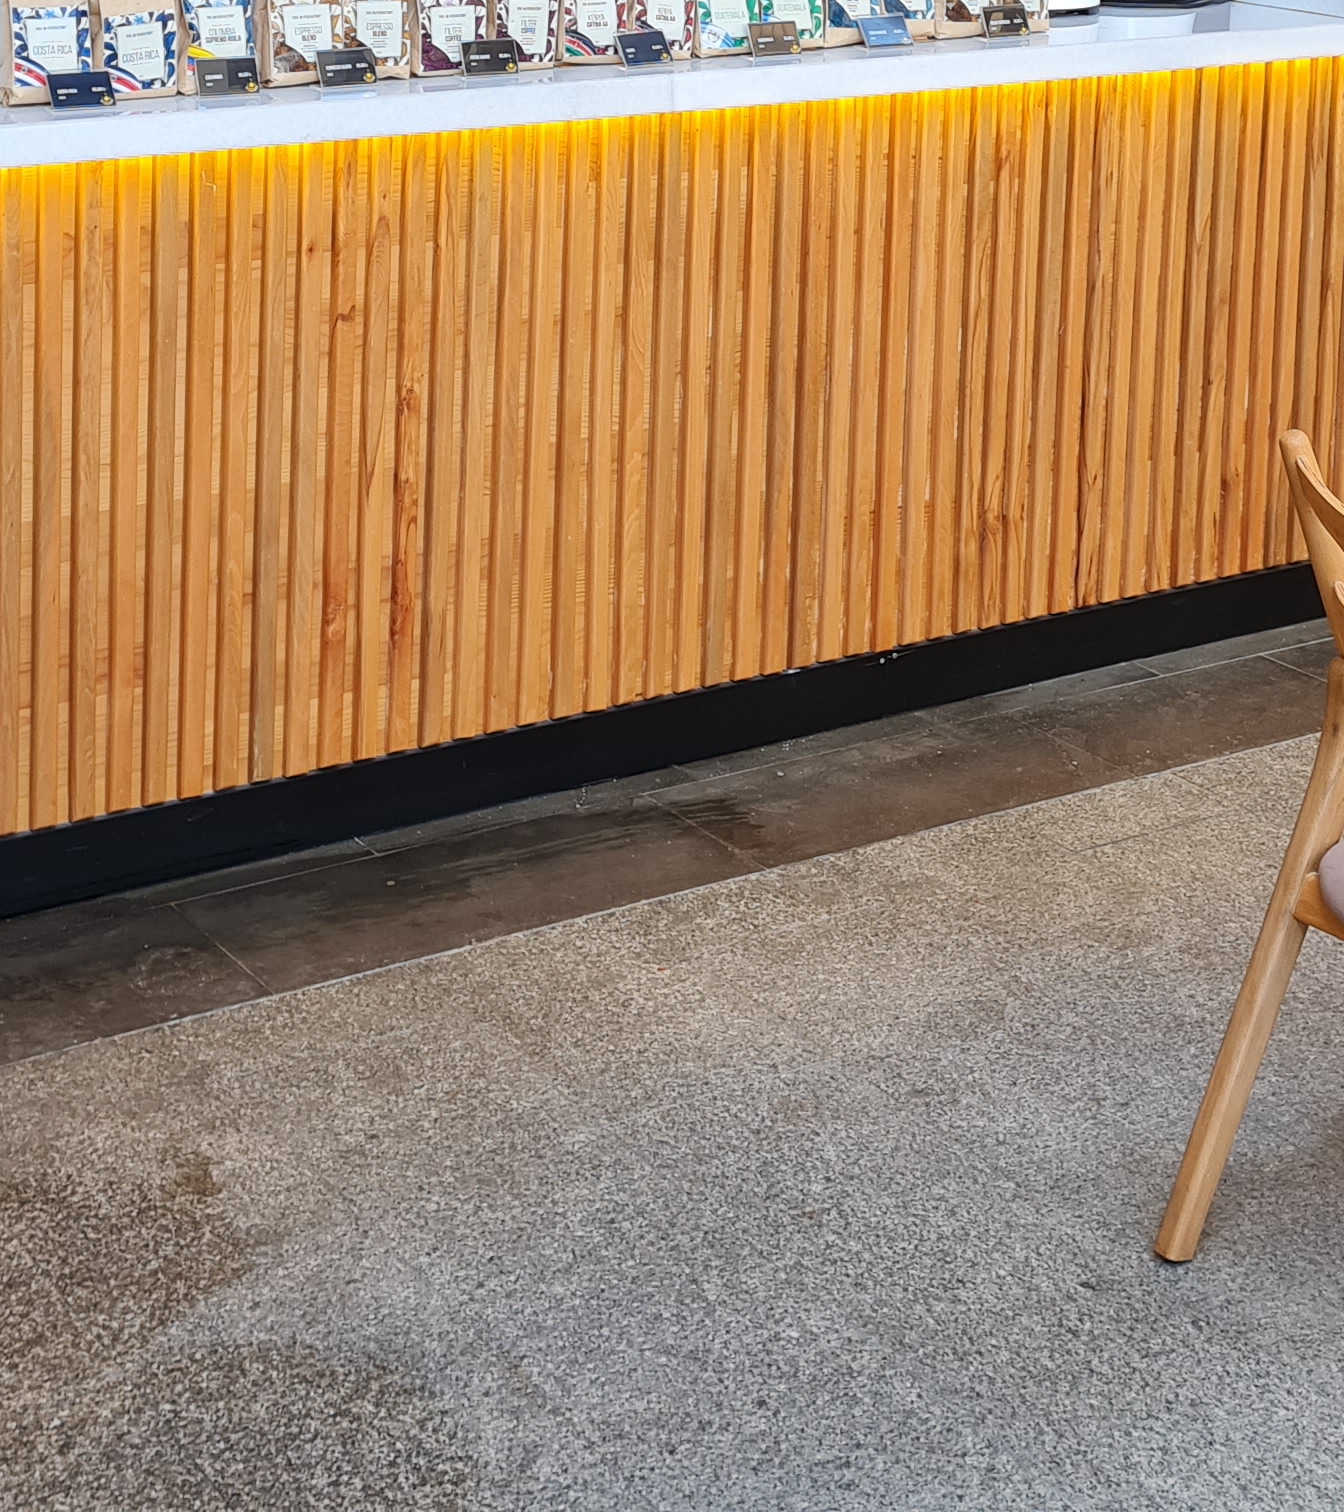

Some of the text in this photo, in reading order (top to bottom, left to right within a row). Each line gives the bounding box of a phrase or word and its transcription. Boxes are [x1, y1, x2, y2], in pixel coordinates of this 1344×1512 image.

[33, 44, 73, 56] COSTA RICA
[122, 50, 160, 64] COSTA RICA
